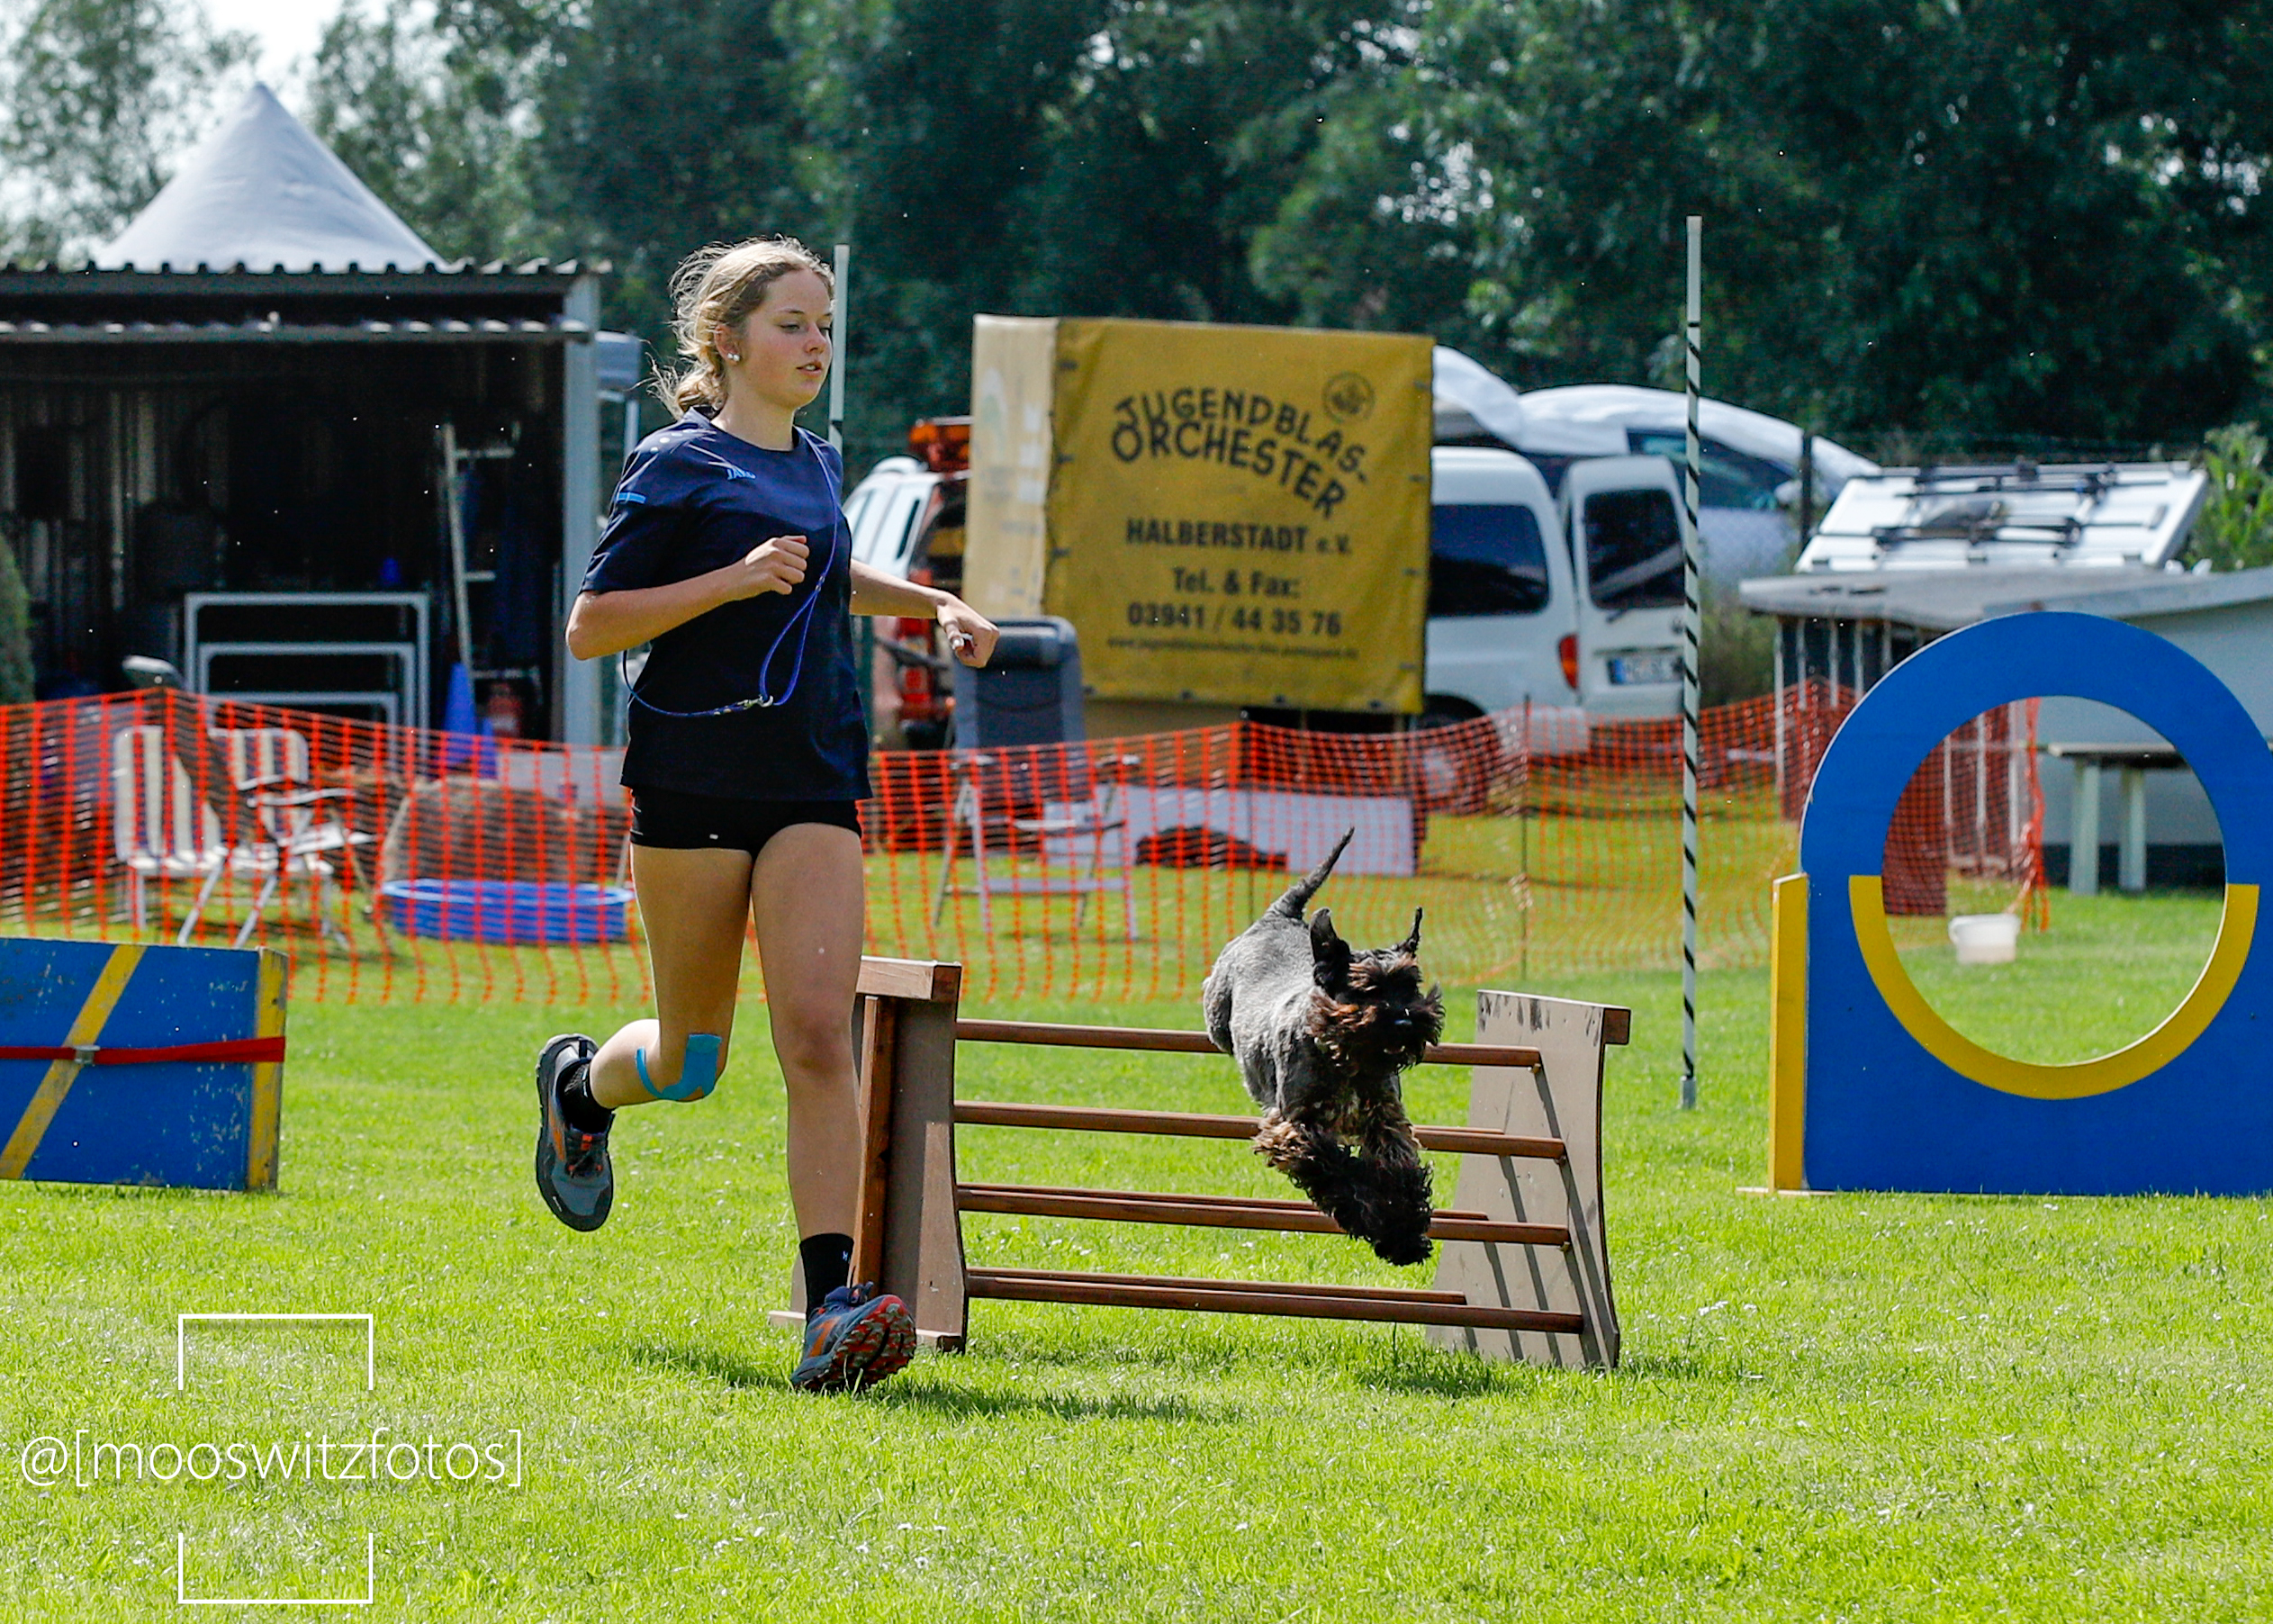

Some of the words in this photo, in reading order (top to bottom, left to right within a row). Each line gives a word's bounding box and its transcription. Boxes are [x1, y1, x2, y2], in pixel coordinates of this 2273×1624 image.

[1114, 387, 1367, 483] JUGENDBLAS-
[1111, 419, 1347, 519] ORCHESTER
[1126, 518, 1309, 553] HALBERSTADT
[1172, 566, 1214, 592] Tel.
[1223, 568, 1240, 595] &
[1249, 570, 1300, 599] Fax:
[1231, 606, 1262, 630] 44
[1271, 607, 1302, 634] 35
[1312, 609, 1341, 636] 76
